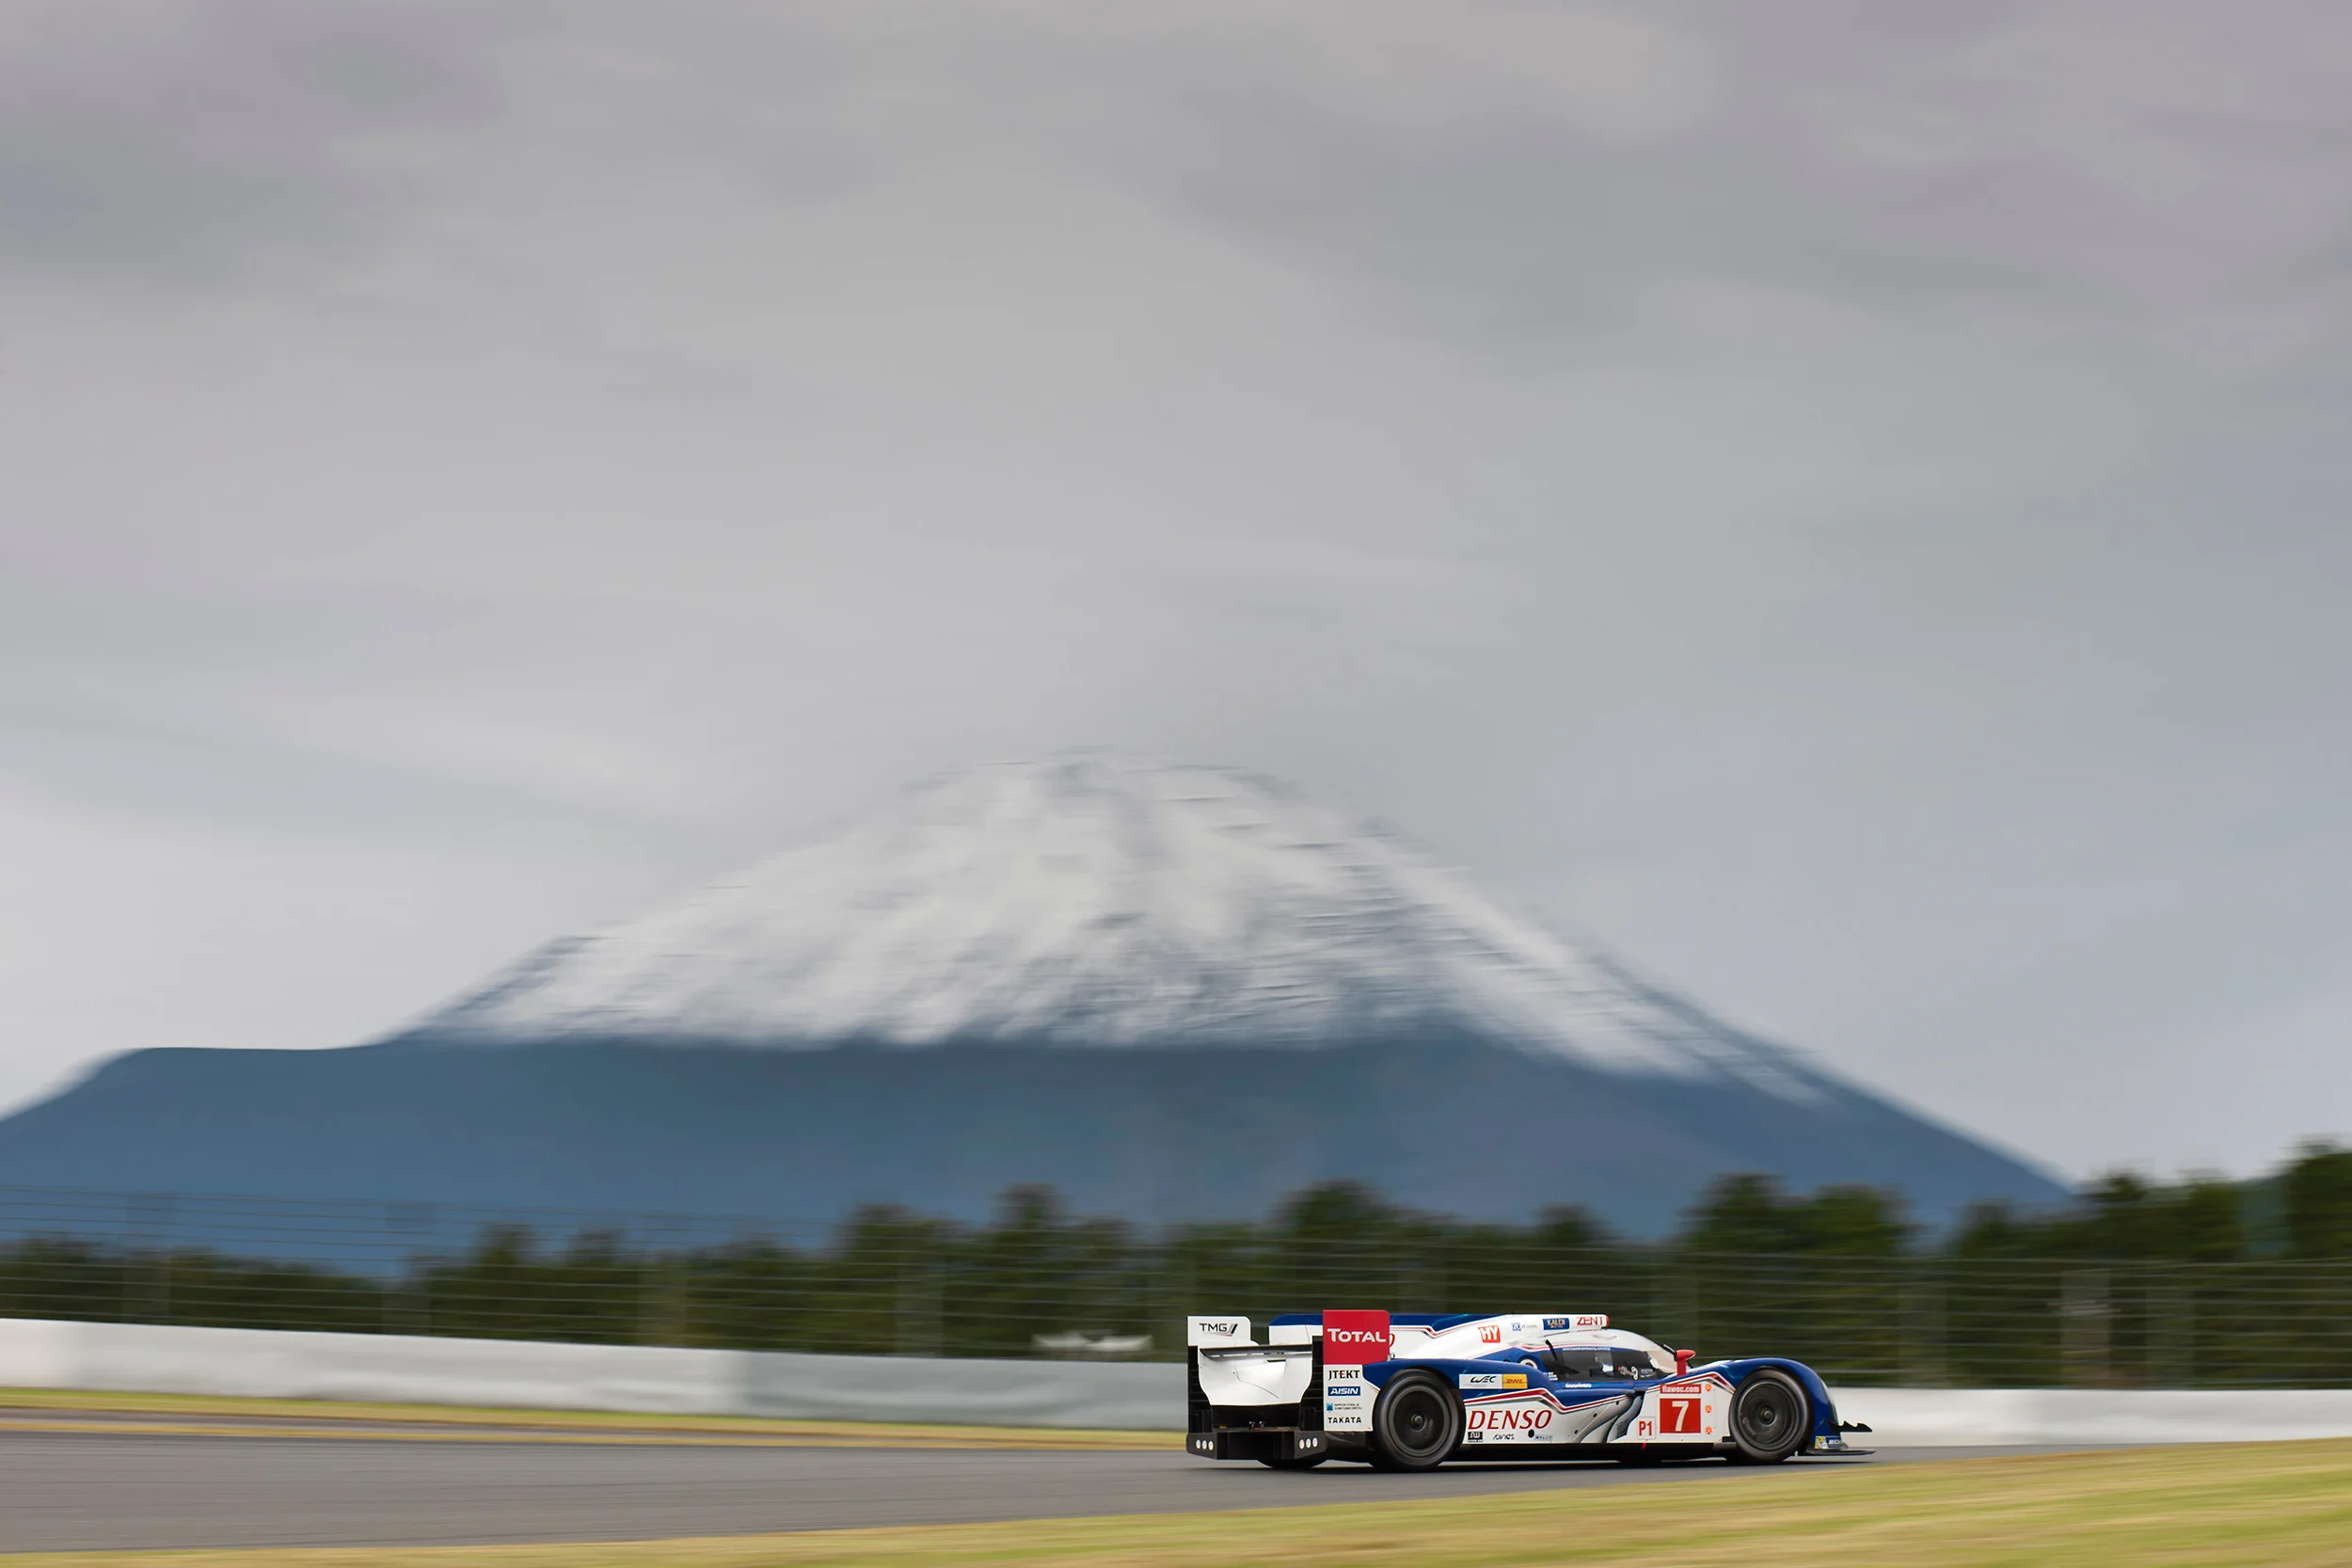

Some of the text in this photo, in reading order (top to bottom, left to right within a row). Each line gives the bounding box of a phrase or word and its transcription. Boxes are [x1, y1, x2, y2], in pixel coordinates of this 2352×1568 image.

[1199, 1323, 1228, 1332] TMG
[1577, 1317, 1603, 1326] ZENT
[1327, 1328, 1387, 1342] TOTAL
[1480, 1326, 1499, 1340] HY
[1327, 1370, 1360, 1381] JTEKT
[1470, 1375, 1497, 1384] WEC
[1661, 1385, 1700, 1393] fiawec.com
[1468, 1409, 1552, 1430] DENSO
[1672, 1401, 1690, 1432] 7
[1639, 1420, 1652, 1436] P1
